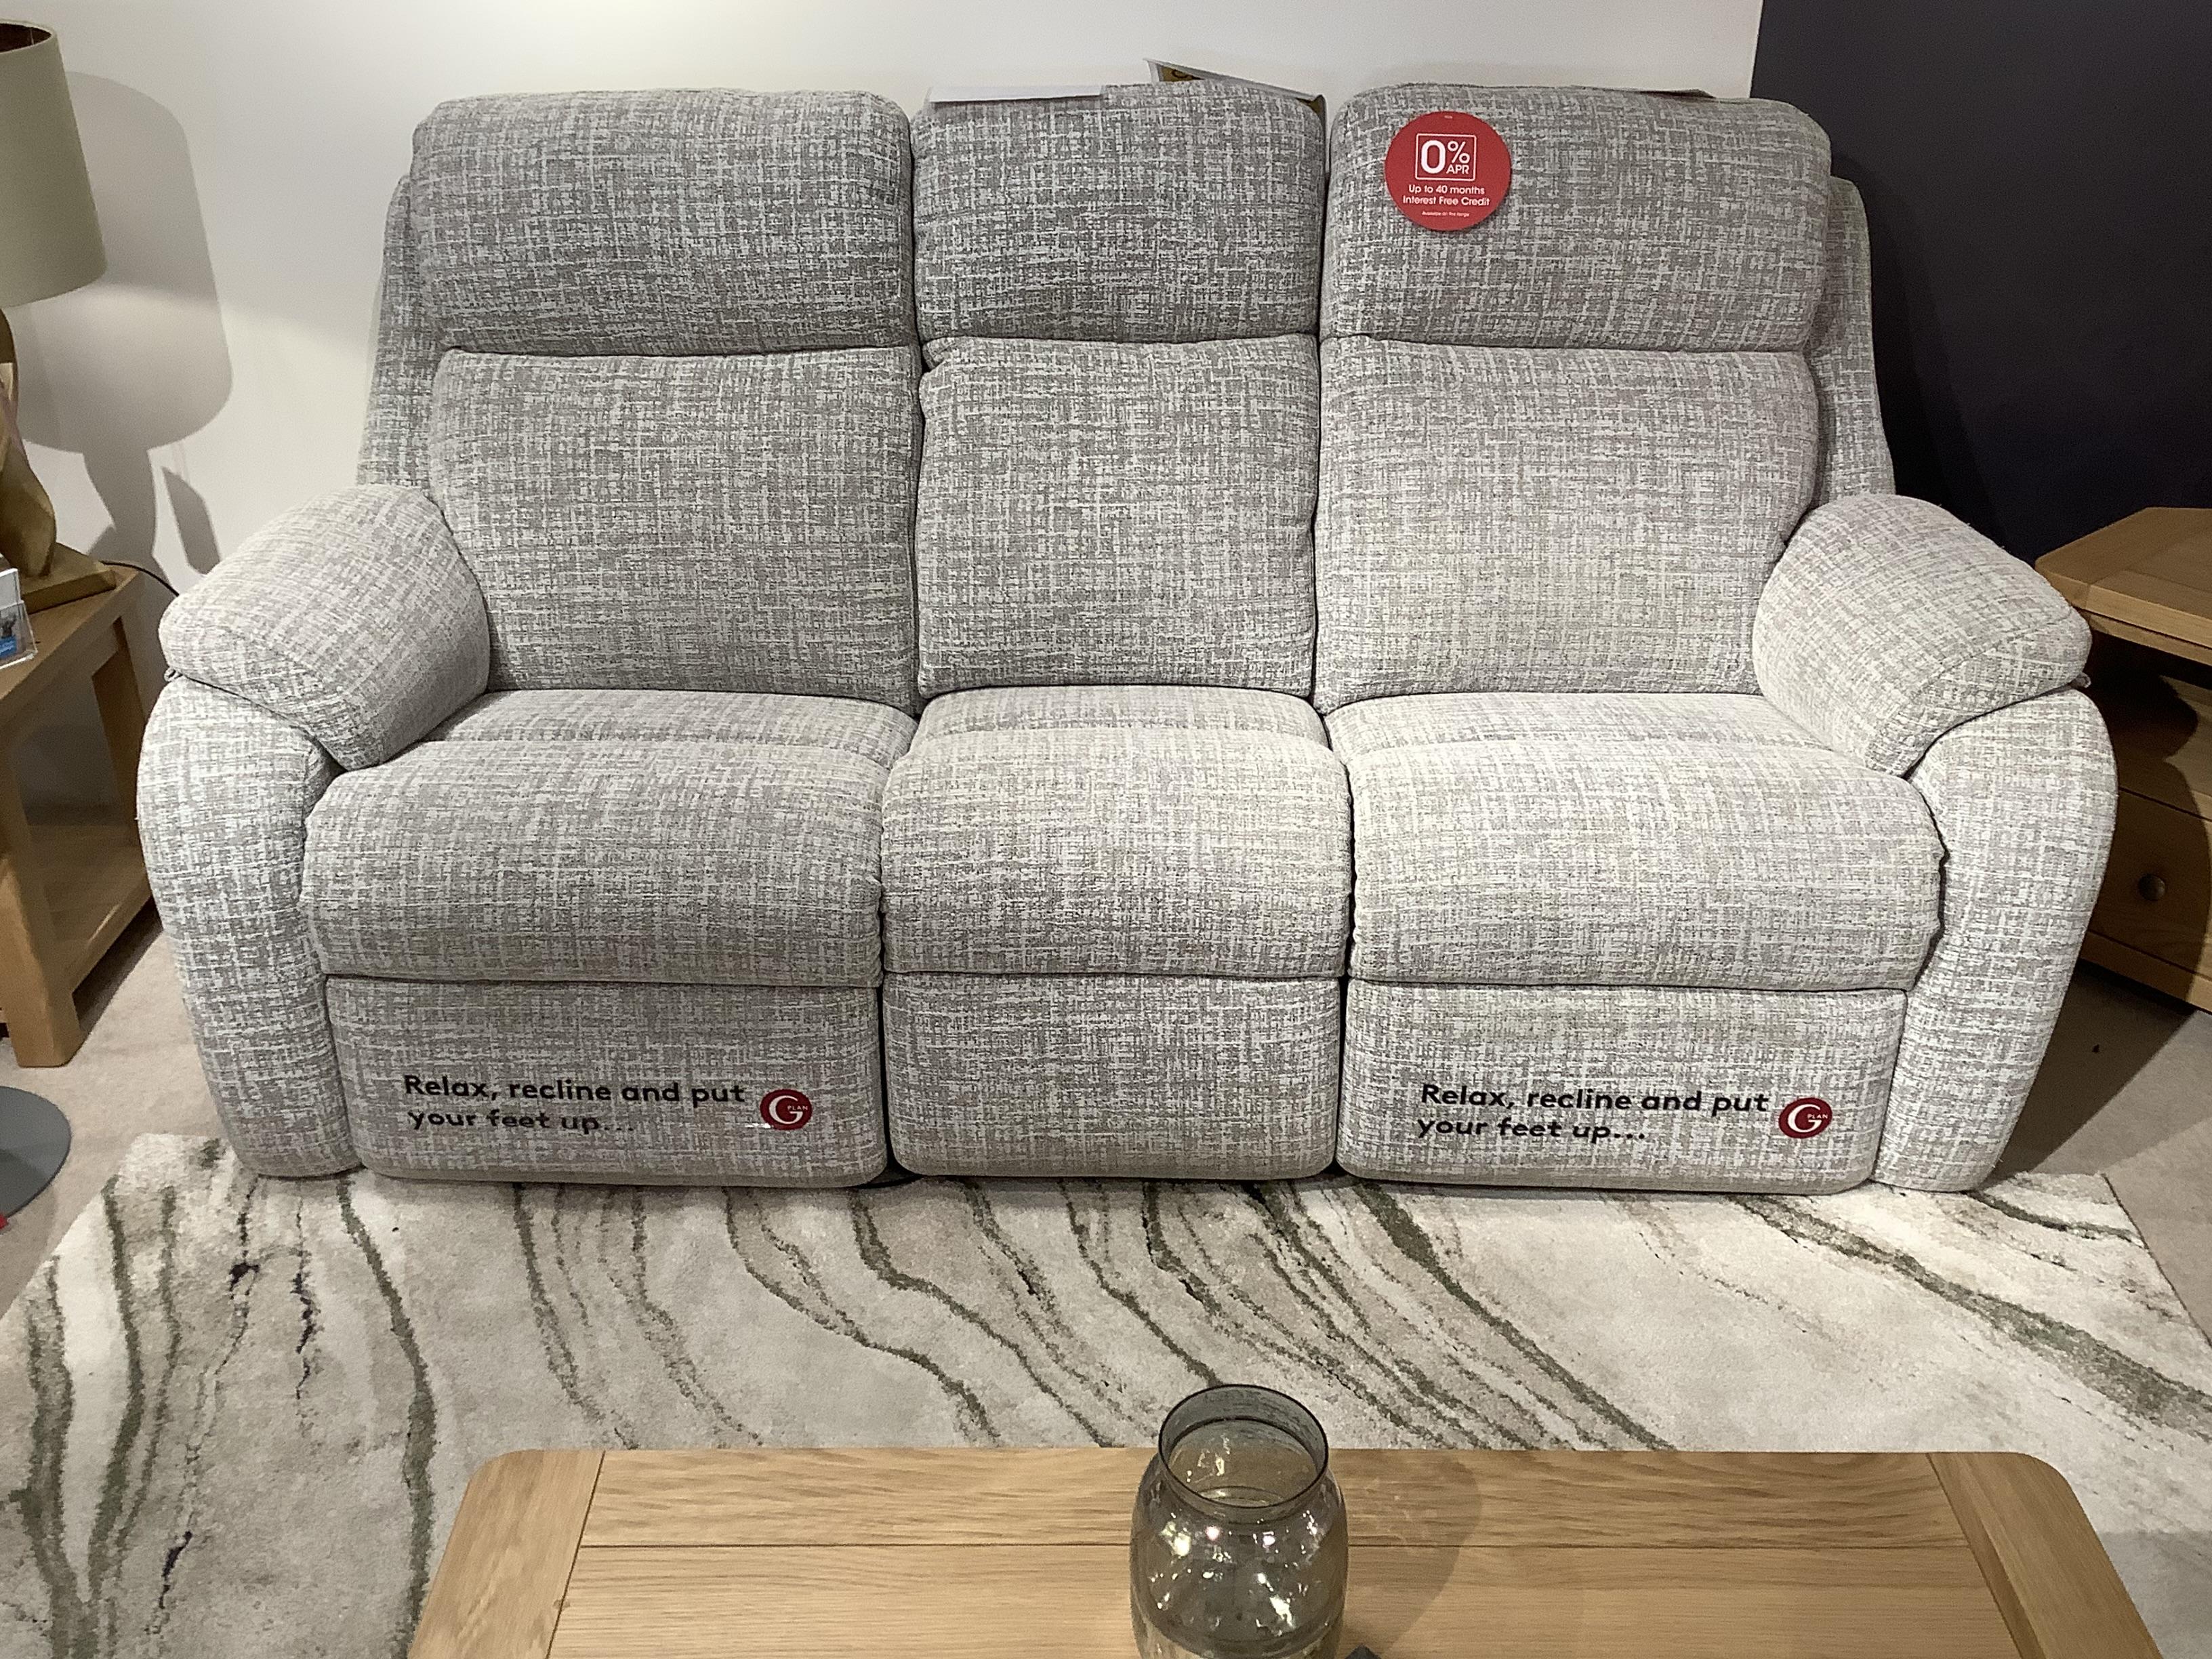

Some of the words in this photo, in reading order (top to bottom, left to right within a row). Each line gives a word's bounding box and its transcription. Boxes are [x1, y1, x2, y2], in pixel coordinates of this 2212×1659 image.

[1421, 140, 1470, 173] 0%
[1446, 165, 1469, 174] APR
[1403, 195, 1436, 204] Interest
[1439, 197, 1458, 205] Free
[1461, 197, 1490, 205] Credit
[1408, 184, 1421, 194] Up
[1436, 185, 1448, 193] 40
[1450, 186, 1485, 194] months
[405, 1075, 497, 1101] Relax,
[510, 1080, 611, 1100] recline
[621, 1082, 680, 1101] and
[691, 1085, 745, 1108] put
[1422, 1084, 1514, 1109] Relax,
[1527, 1088, 1632, 1109] recline
[1641, 1090, 1702, 1111] and
[1712, 1094, 1769, 1116] put
[408, 1111, 476, 1130] your
[486, 1109, 550, 1128] feet
[769, 1095, 804, 1124] G
[1787, 1104, 1822, 1132] G
[1418, 1119, 1488, 1138] your
[1497, 1118, 1562, 1137] feet
